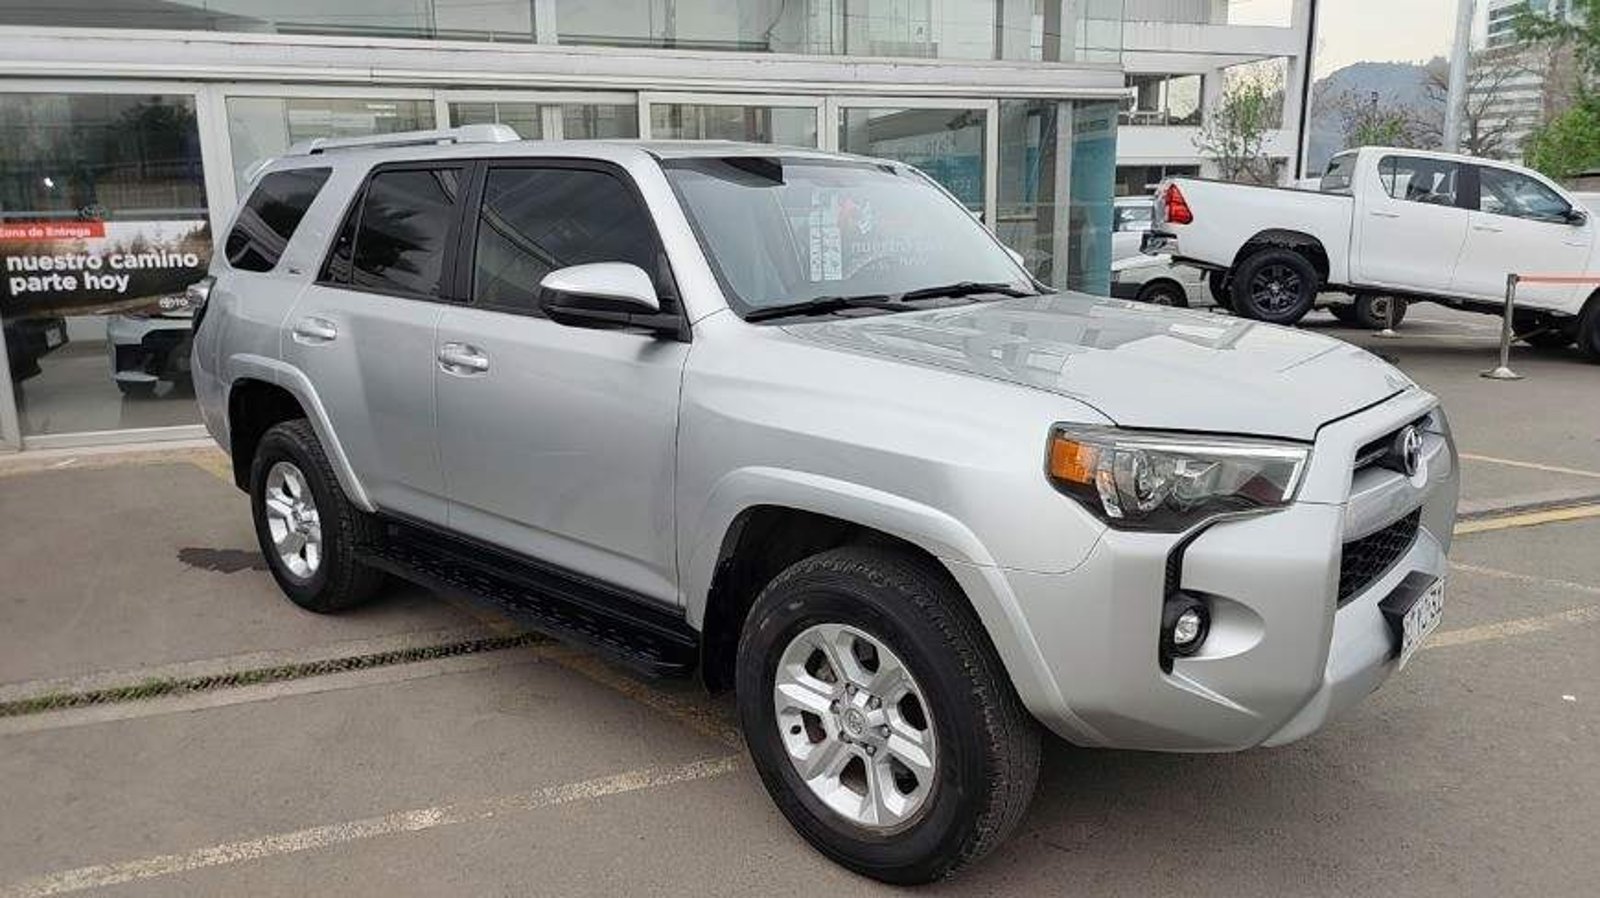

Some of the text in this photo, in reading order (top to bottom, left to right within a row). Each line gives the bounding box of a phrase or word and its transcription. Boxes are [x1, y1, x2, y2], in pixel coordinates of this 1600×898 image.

[30, 227, 44, 237] de
[7, 249, 199, 271] nuestro camino
[10, 271, 129, 295] parte hoy
